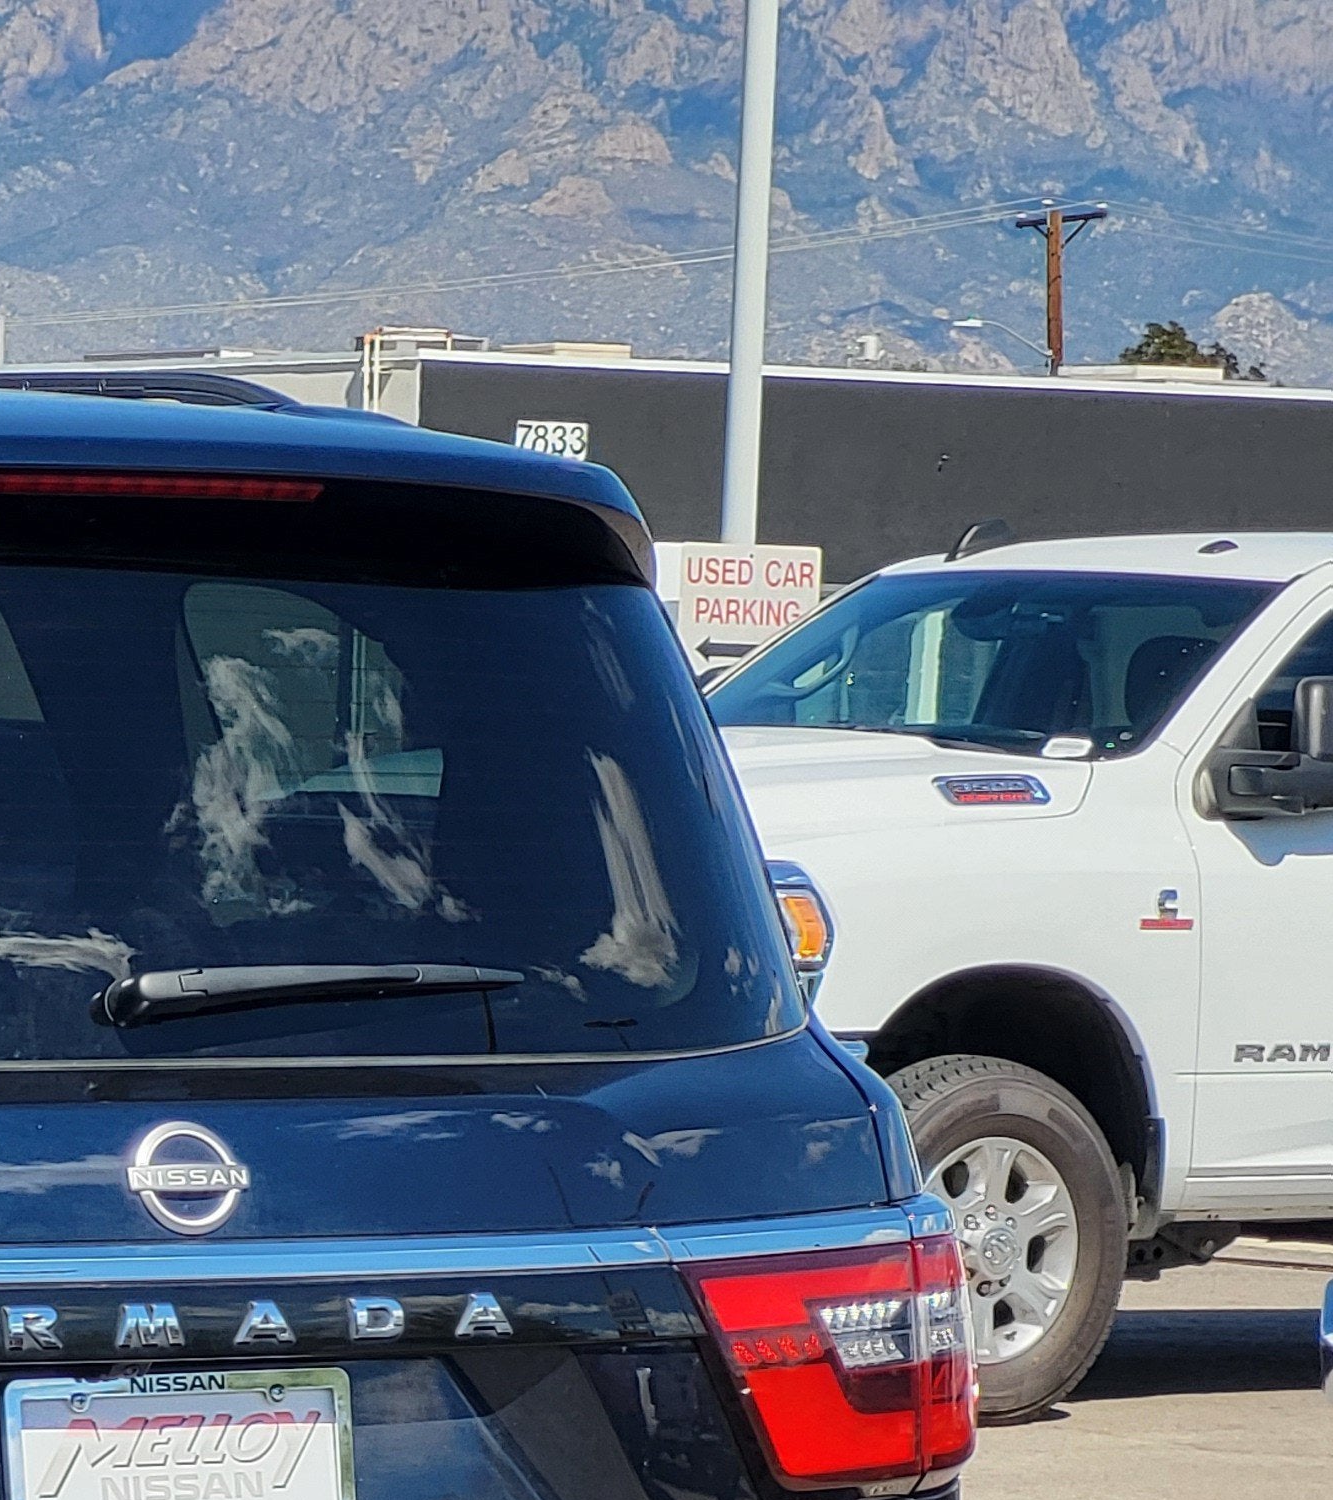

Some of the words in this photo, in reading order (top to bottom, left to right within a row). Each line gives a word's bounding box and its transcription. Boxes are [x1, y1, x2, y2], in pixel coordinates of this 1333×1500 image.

[517, 424, 586, 457] 7833
[687, 557, 753, 586] USED
[765, 560, 815, 588] CAR
[695, 597, 800, 627] PARKING
[1234, 1044, 1330, 1062] RAM
[133, 1169, 248, 1186] NISSAN
[130, 1374, 226, 1393] NISSAN
[38, 1410, 321, 1498] MELLOY
